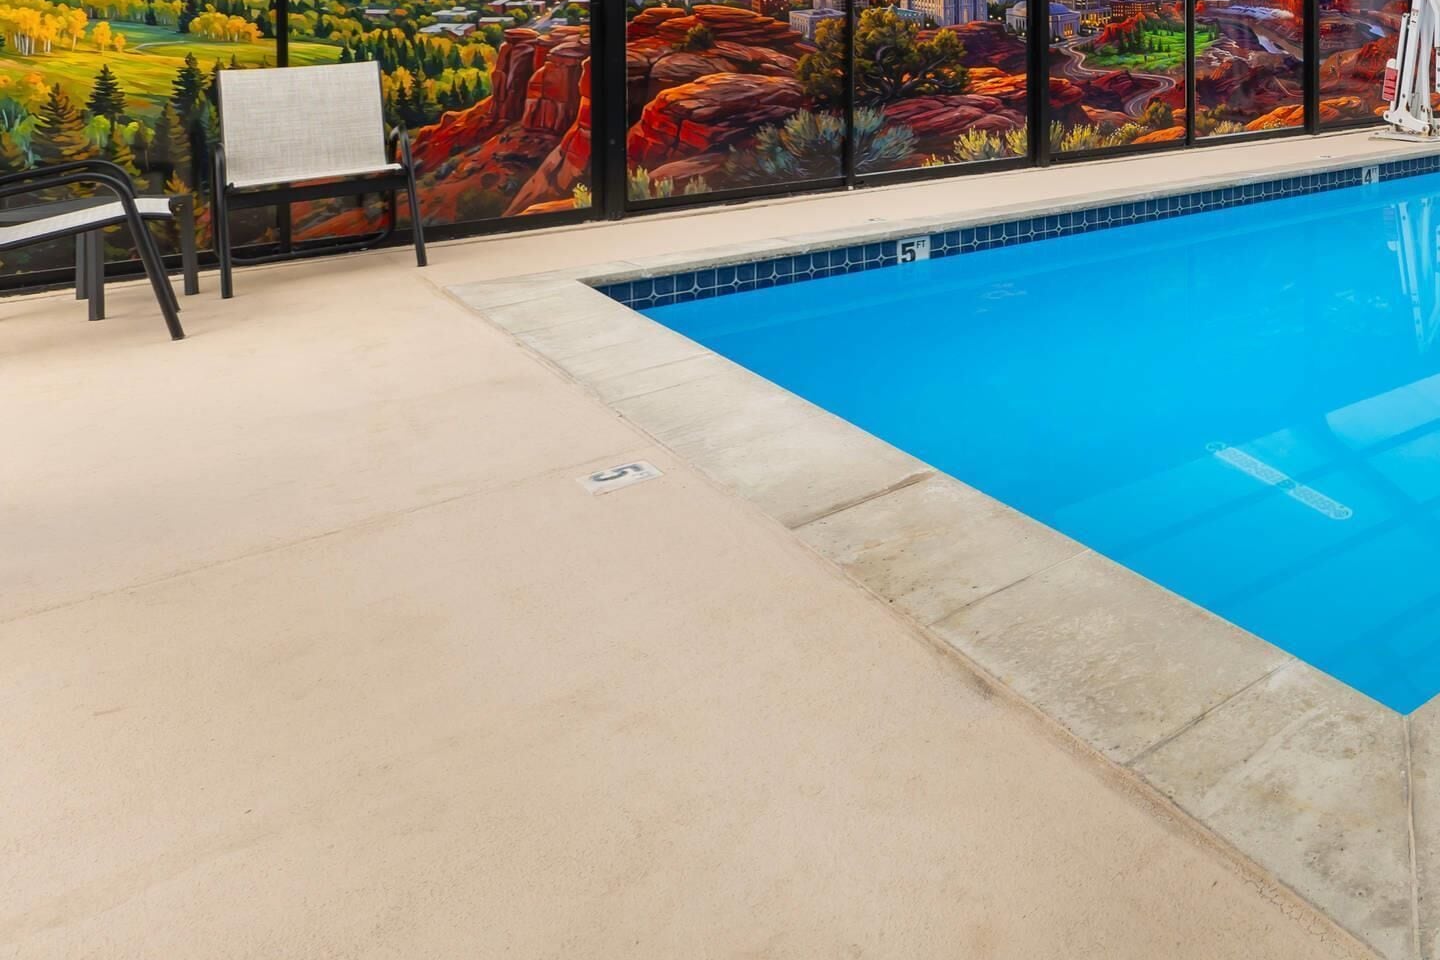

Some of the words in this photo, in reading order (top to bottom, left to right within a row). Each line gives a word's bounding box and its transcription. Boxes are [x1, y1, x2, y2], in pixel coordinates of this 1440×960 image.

[1365, 168, 1372, 184] 4
[901, 241, 916, 263] 5
[916, 239, 926, 249] FT
[592, 463, 643, 482] 5
